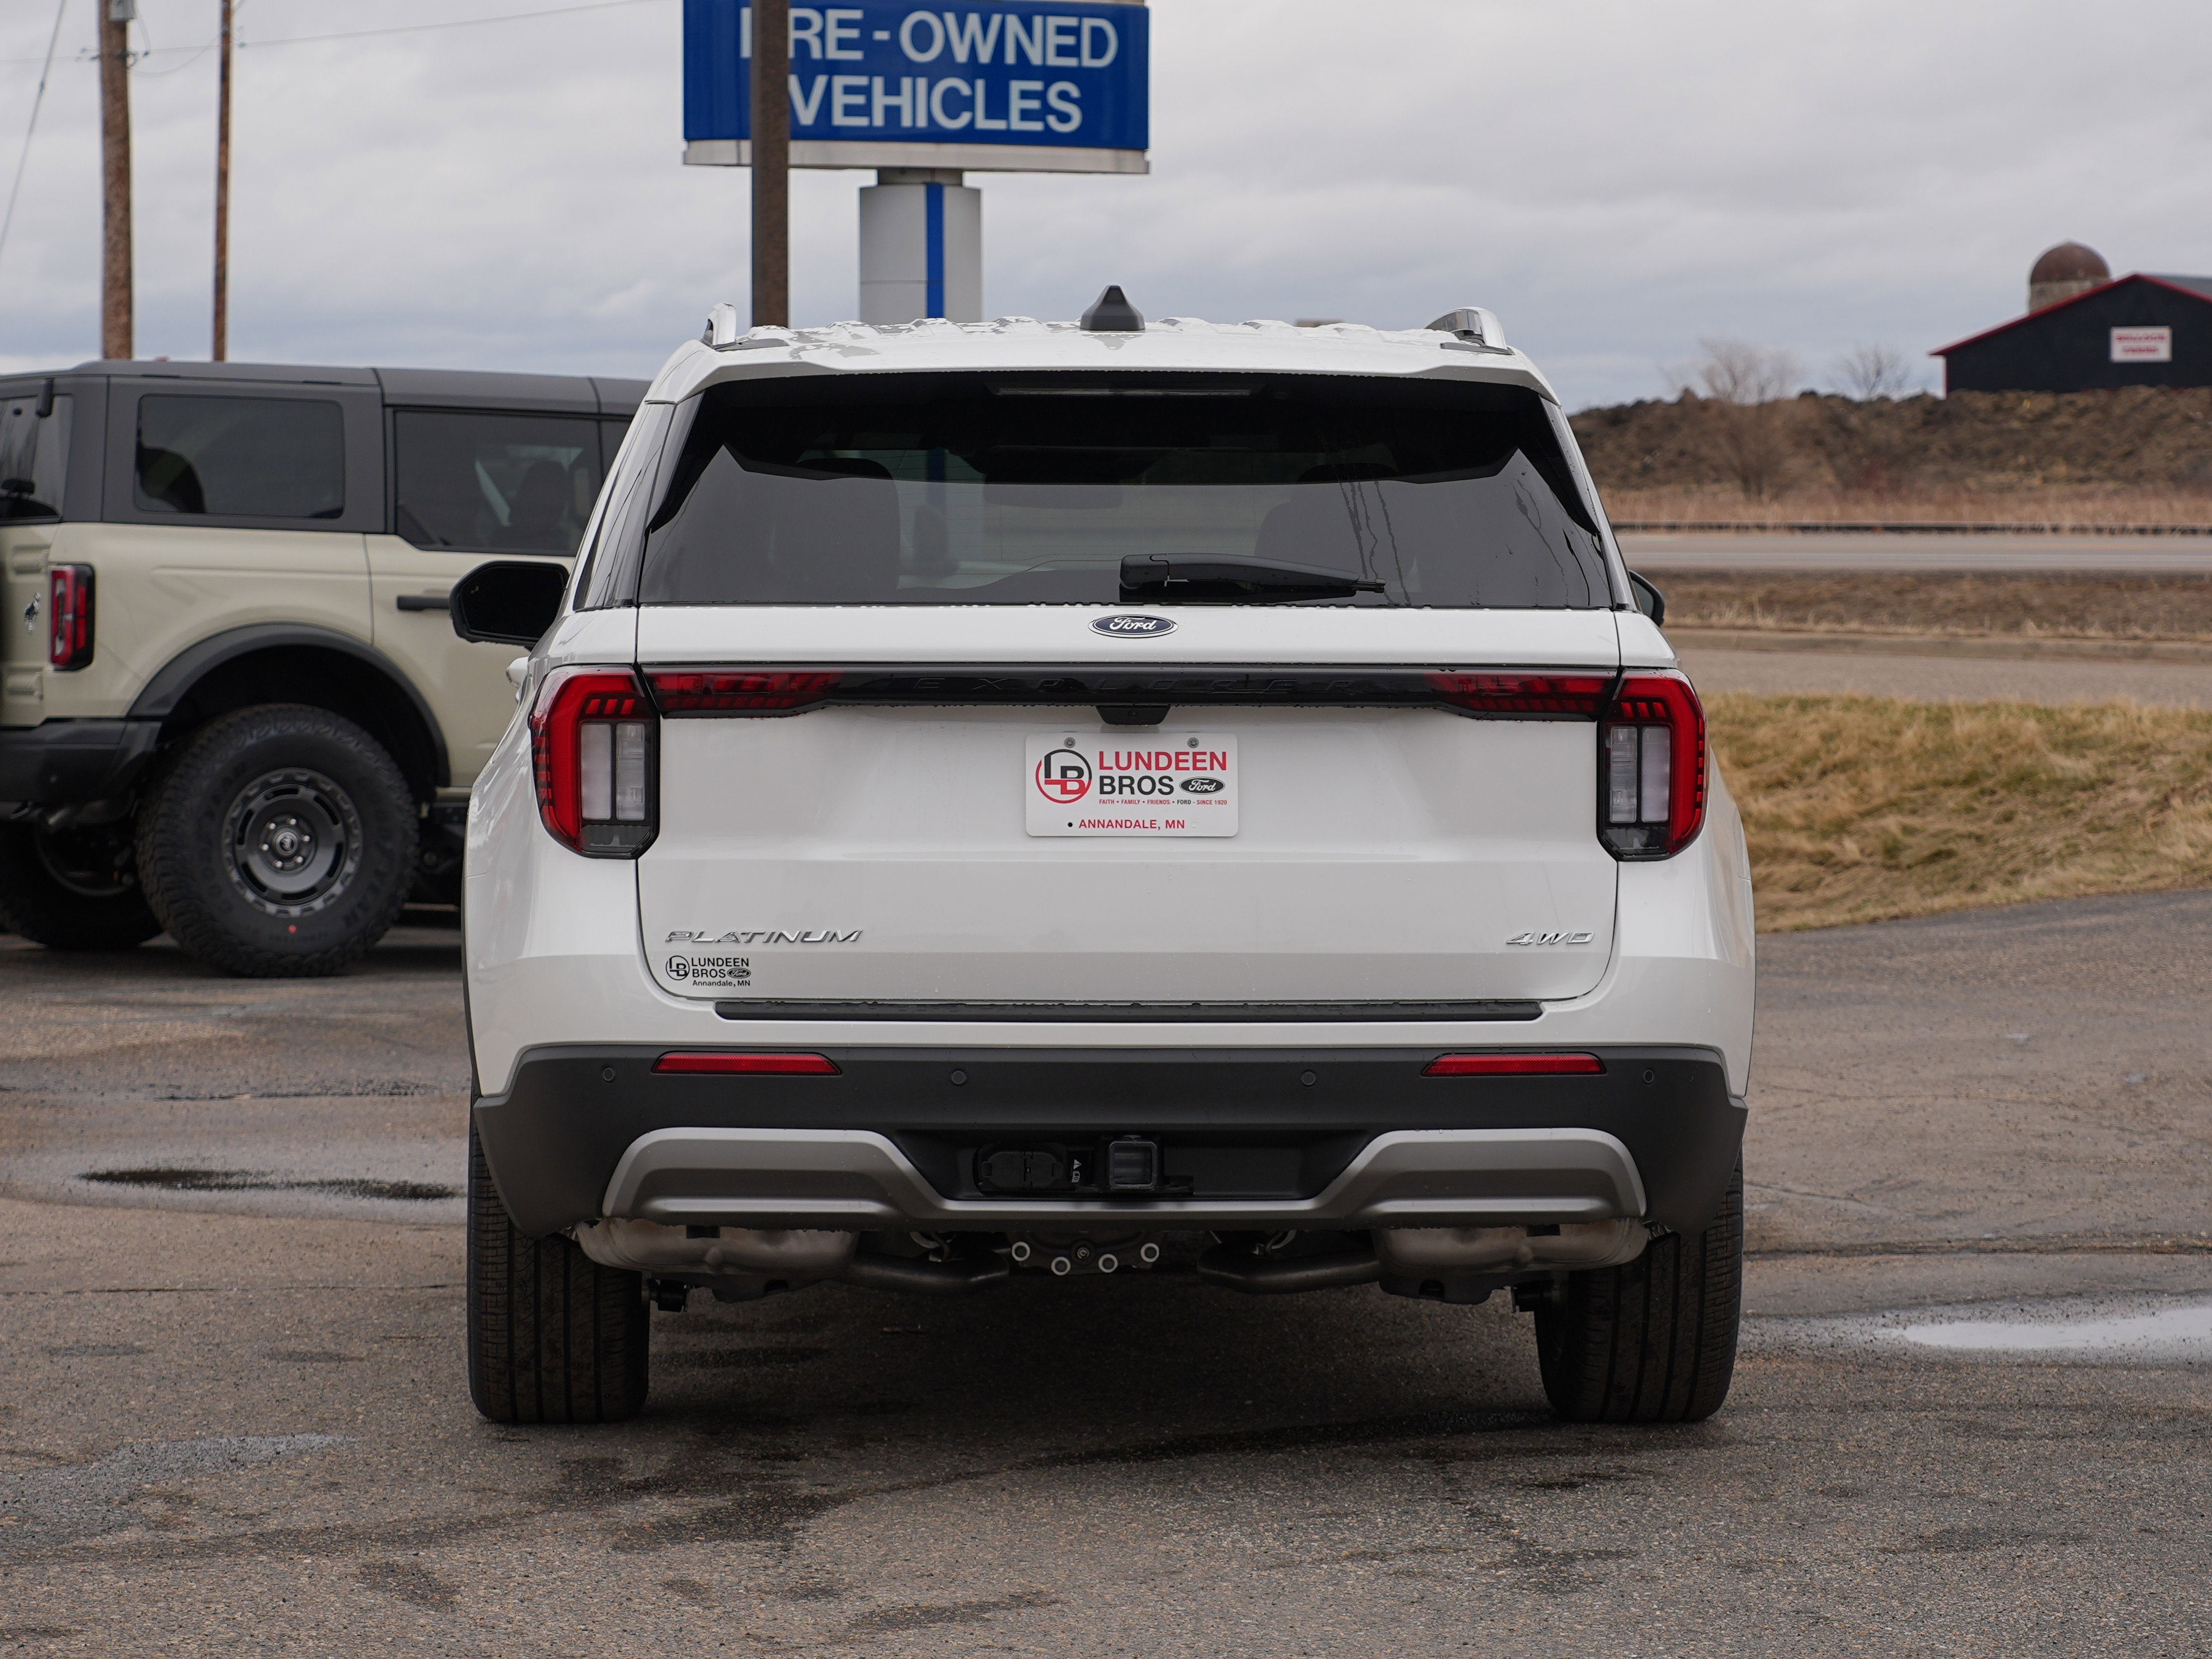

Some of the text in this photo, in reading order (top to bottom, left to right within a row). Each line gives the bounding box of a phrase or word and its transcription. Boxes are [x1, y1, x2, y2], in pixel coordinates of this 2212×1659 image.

[787, 74, 1082, 133] VEHICLES
[1109, 617, 1157, 630] Ford
[1098, 751, 1227, 771] LUNDEEN
[1099, 775, 1175, 795] BROS
[1078, 819, 1185, 831] ANNANDALE, MN
[665, 930, 864, 943] PLATINUM
[1506, 932, 1595, 945] 4WD
[691, 957, 749, 967] LUNDEEN
[692, 969, 726, 978] BROS
